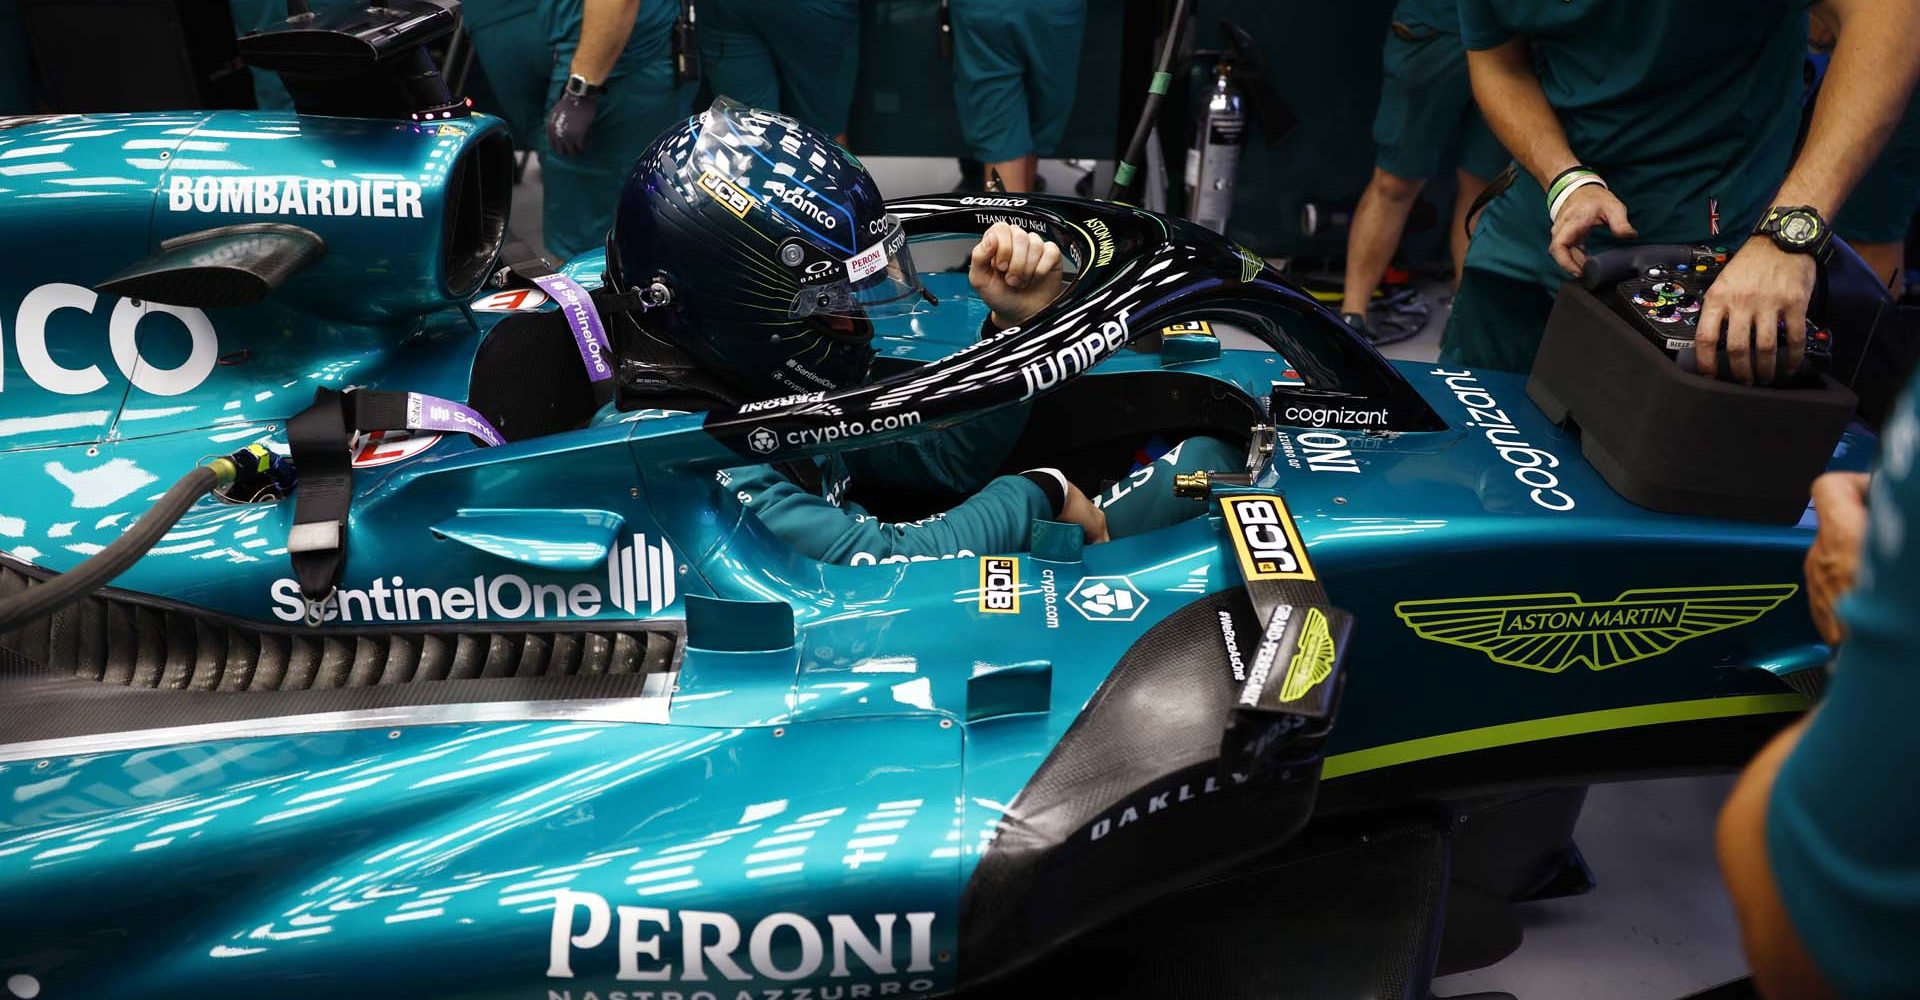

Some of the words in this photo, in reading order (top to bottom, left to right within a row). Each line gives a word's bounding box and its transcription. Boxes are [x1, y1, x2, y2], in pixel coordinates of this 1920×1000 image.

[168, 175, 424, 219] BOMBARDIER
[703, 176, 750, 212] JCB
[773, 184, 836, 229] aramco
[960, 196, 1028, 207] aramco
[975, 213, 1007, 224] THANK
[1009, 215, 1028, 228] YOU
[1083, 217, 1112, 241] ASTON
[800, 267, 840, 283] OAKLEY
[851, 250, 880, 270] PERONI
[0, 283, 218, 396] co
[564, 289, 605, 373] SentinelOne
[795, 364, 836, 390] SentinelOne
[786, 411, 921, 444] crypto.com
[1285, 406, 1388, 427] cognizant
[1430, 368, 1575, 511] cognizant
[1236, 501, 1298, 572] JCB
[987, 560, 1012, 609] JCB
[1040, 569, 1059, 628] crypto.com
[1507, 612, 1582, 632] ASTON
[1588, 606, 1677, 628] MARTIN
[546, 888, 936, 982] PERONI
[733, 979, 934, 1000] AZZURRO
